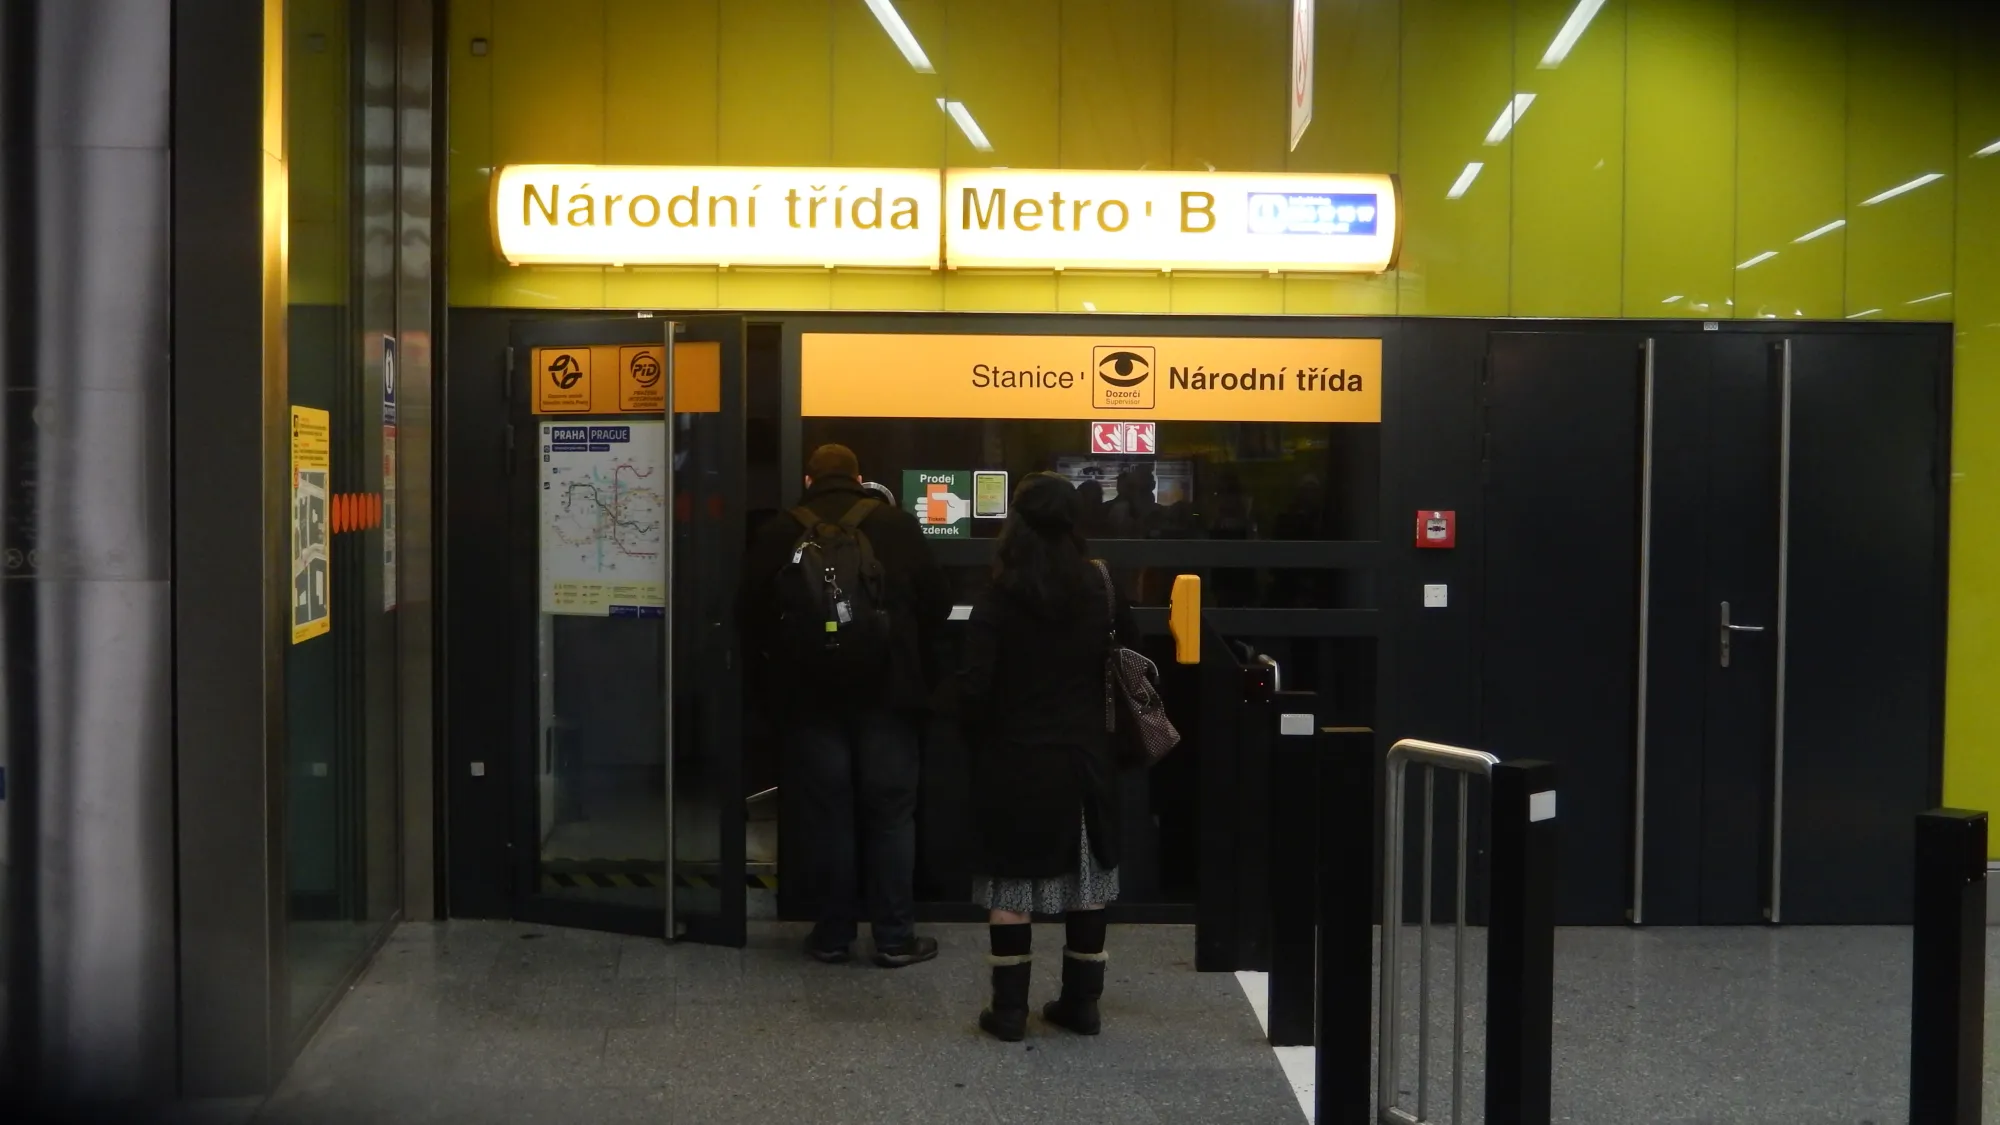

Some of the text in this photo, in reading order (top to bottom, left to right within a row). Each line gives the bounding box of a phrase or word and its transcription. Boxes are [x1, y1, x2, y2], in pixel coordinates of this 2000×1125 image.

[522, 183, 919, 230] Národní třída
[962, 187, 1217, 233] Metro B
[972, 364, 1074, 389] Stanice
[1169, 366, 1363, 392] Národní třída
[1106, 389, 1140, 398] Dozorčí
[1105, 398, 1140, 406] Supervisor
[554, 429, 628, 440] PRAHA PRAGUE
[920, 474, 955, 485] Prodej
[921, 525, 959, 535] zdenek
